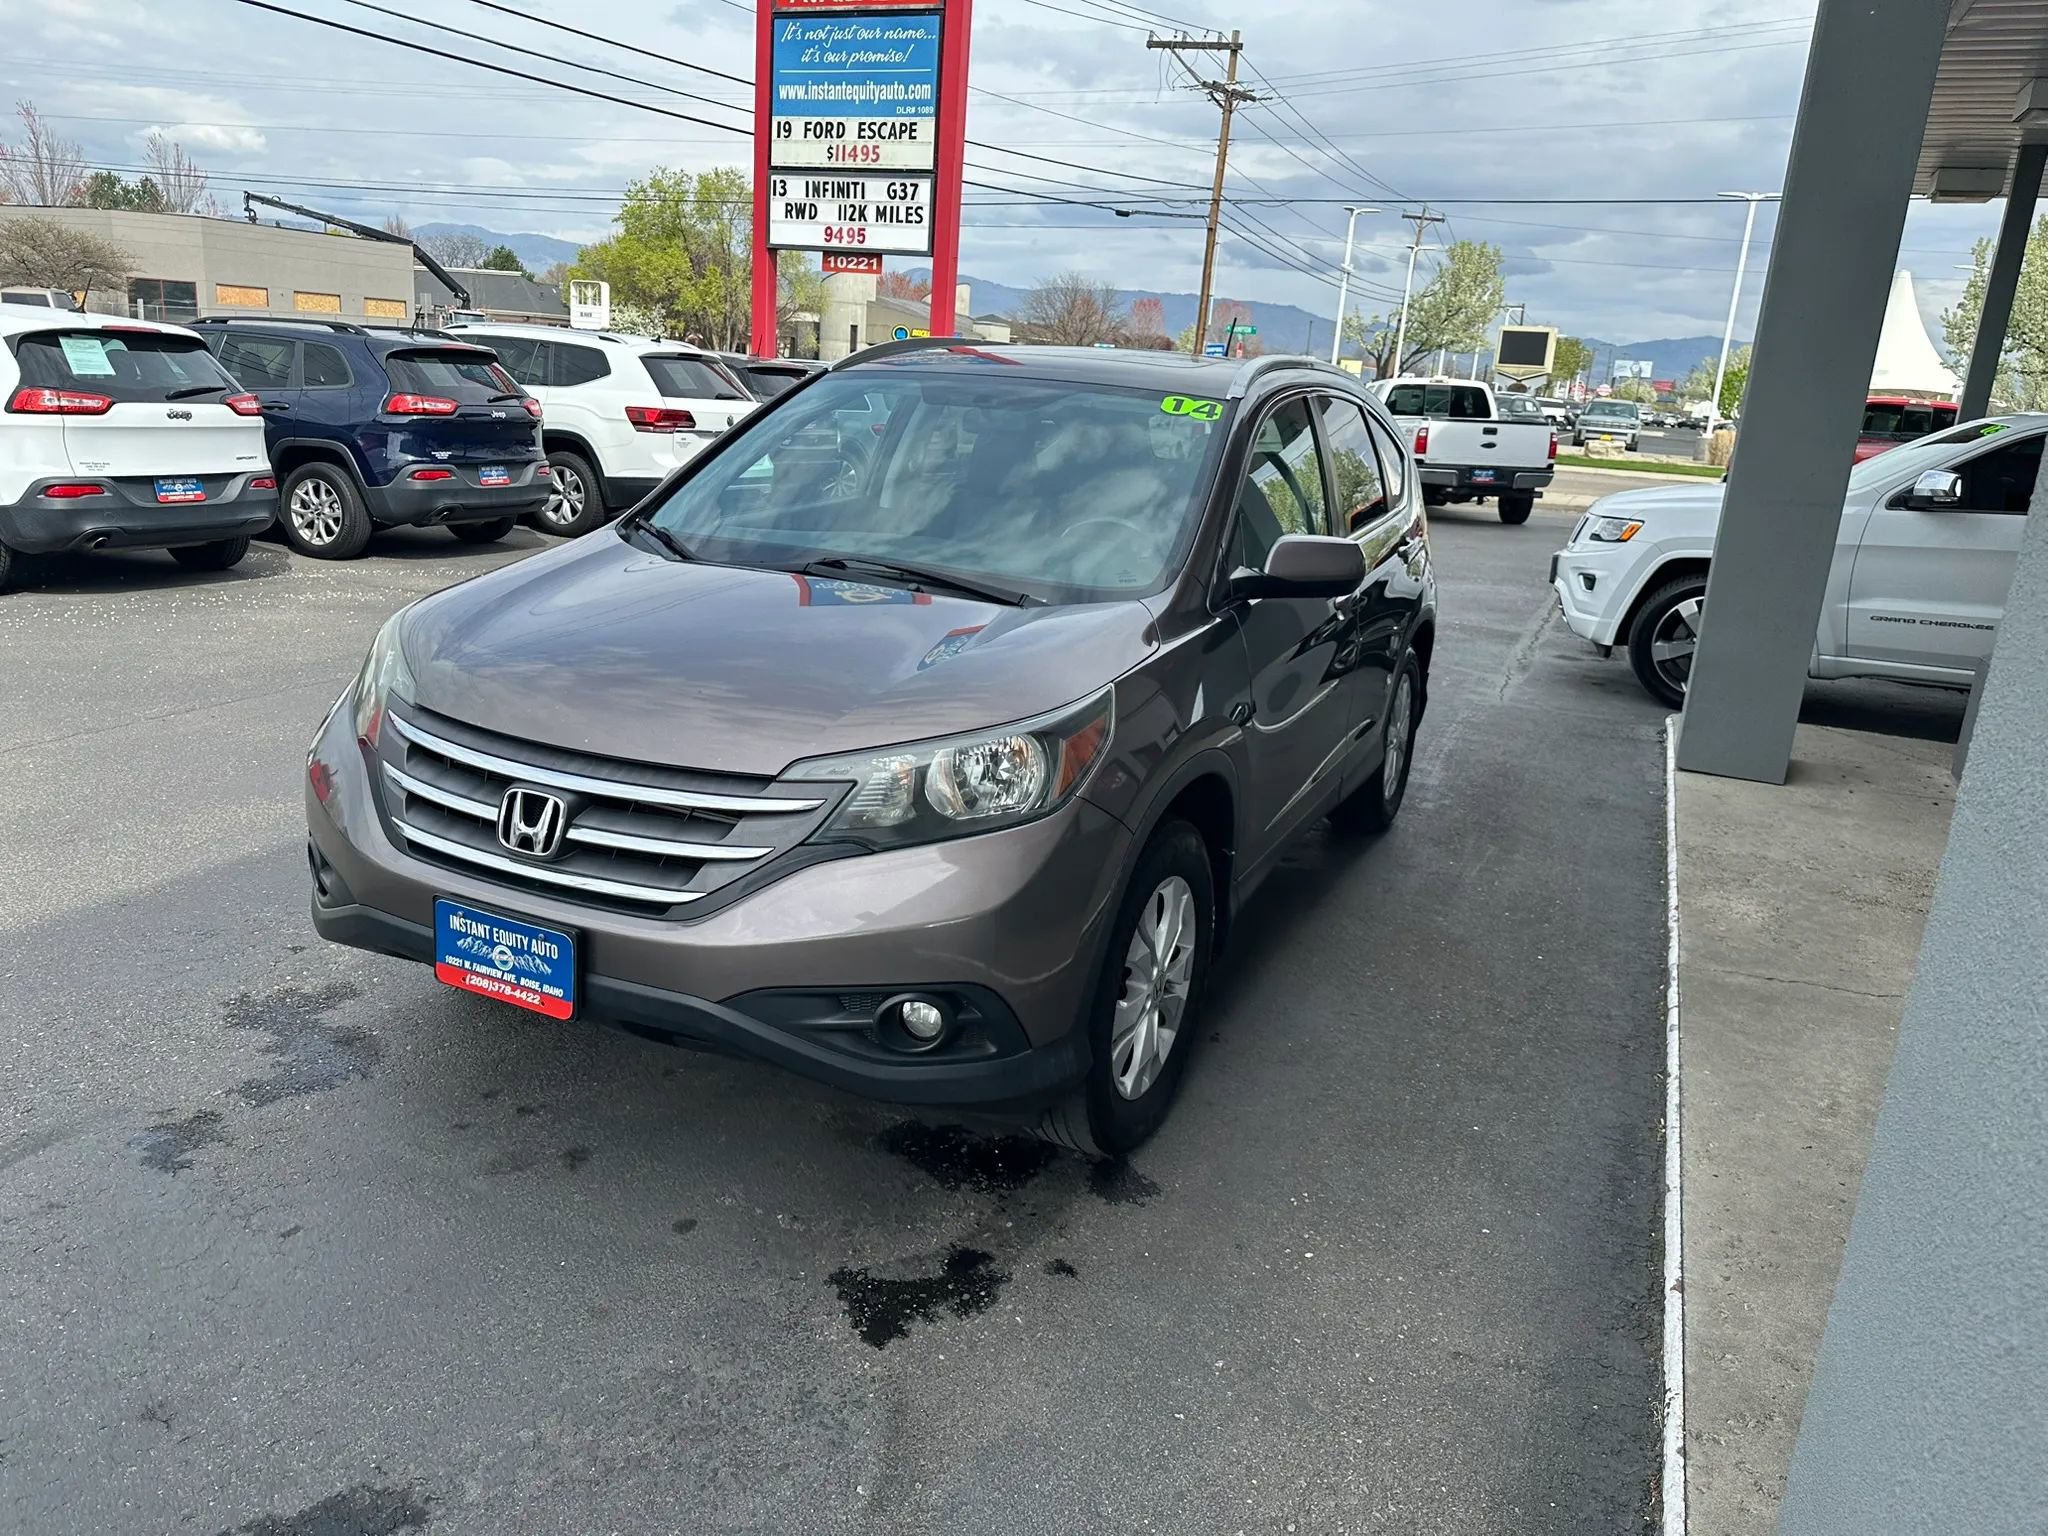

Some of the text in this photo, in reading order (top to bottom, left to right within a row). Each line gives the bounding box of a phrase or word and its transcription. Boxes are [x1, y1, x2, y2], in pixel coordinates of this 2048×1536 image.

[781, 22, 802, 42] It's
[804, 24, 830, 40] not
[823, 25, 857, 48] just
[856, 27, 881, 39] our
[801, 44, 914, 69] it's our promise!
[779, 80, 931, 104] www.instantequityauto.com
[917, 106, 934, 114] 1089
[776, 120, 918, 141] 19 FORD ESCAPE
[827, 144, 880, 163] $11495
[772, 179, 919, 200] 13 INFINITI G37
[784, 203, 924, 224] RWD 112K MILES
[824, 226, 866, 244] 9495
[826, 256, 878, 270] 10221
[1172, 398, 1219, 418] 14
[1870, 615, 1995, 631] GRAND CHEROKEE
[449, 914, 559, 960] INSTANT EQUITY AUTO
[445, 954, 463, 967] 10221
[463, 960, 472, 970] W.
[472, 962, 503, 979] FAIRVIEW
[503, 972, 518, 984] AVE.
[542, 984, 564, 998] IDAHO
[465, 973, 541, 1005] (208)378-4422
